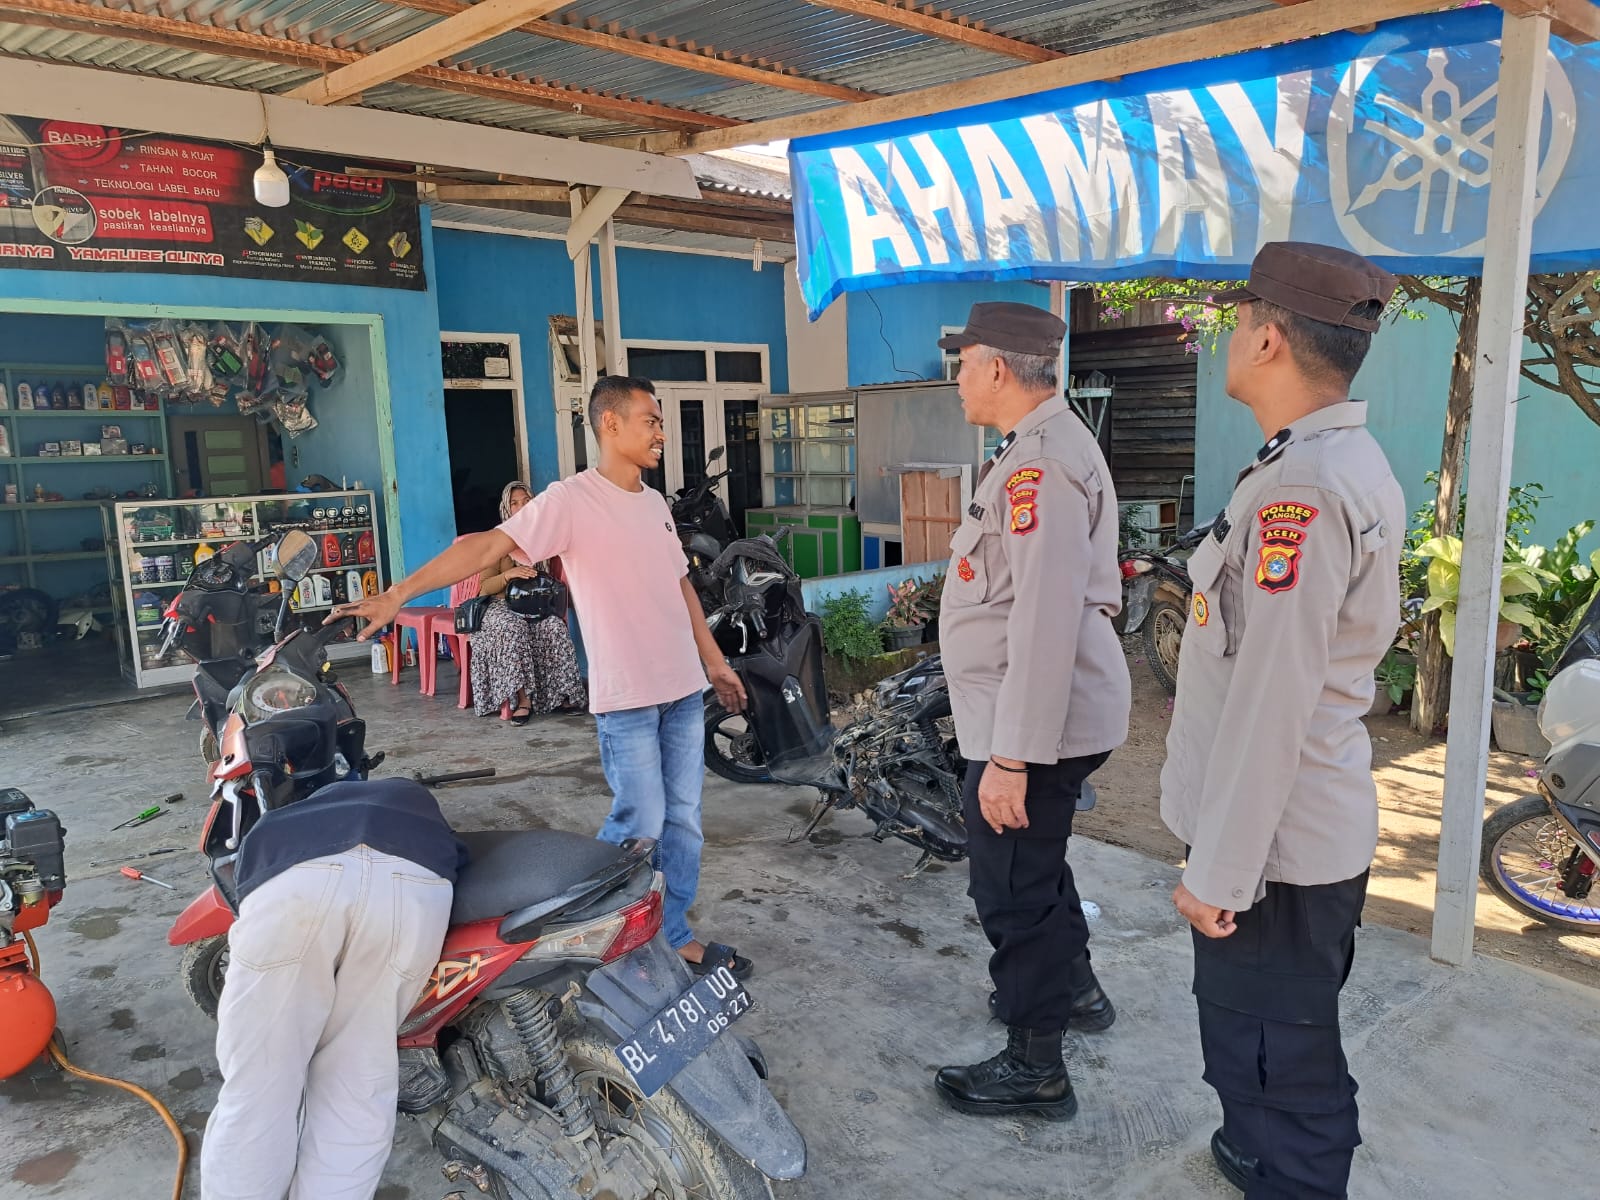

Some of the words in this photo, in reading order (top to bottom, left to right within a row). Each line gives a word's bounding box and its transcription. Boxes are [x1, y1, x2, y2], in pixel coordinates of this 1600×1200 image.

[140, 145, 178, 157] RINGAN
[182, 150, 188, 159] &
[191, 151, 214, 162] KUAT
[140, 163, 173, 175] TAHAN
[182, 167, 217, 180] BOCOR
[94, 178, 154, 191] TEKNOLOGI
[158, 183, 190, 194] LABEL
[193, 186, 220, 198] BARU
[99, 207, 141, 220] sobek
[148, 208, 206, 226] labelnya
[103, 221, 145, 231] pastikan
[150, 222, 207, 236] keasliannya
[0, 243, 54, 258] RNYA
[66, 246, 163, 263] YAMALUBE
[165, 250, 224, 267] OLINYA
[1261, 504, 1313, 518] POLRES
[1267, 512, 1301, 521] LANGSA
[1265, 529, 1299, 540] ACEH
[621, 1039, 657, 1074] BL
[650, 992, 707, 1044] 4781
